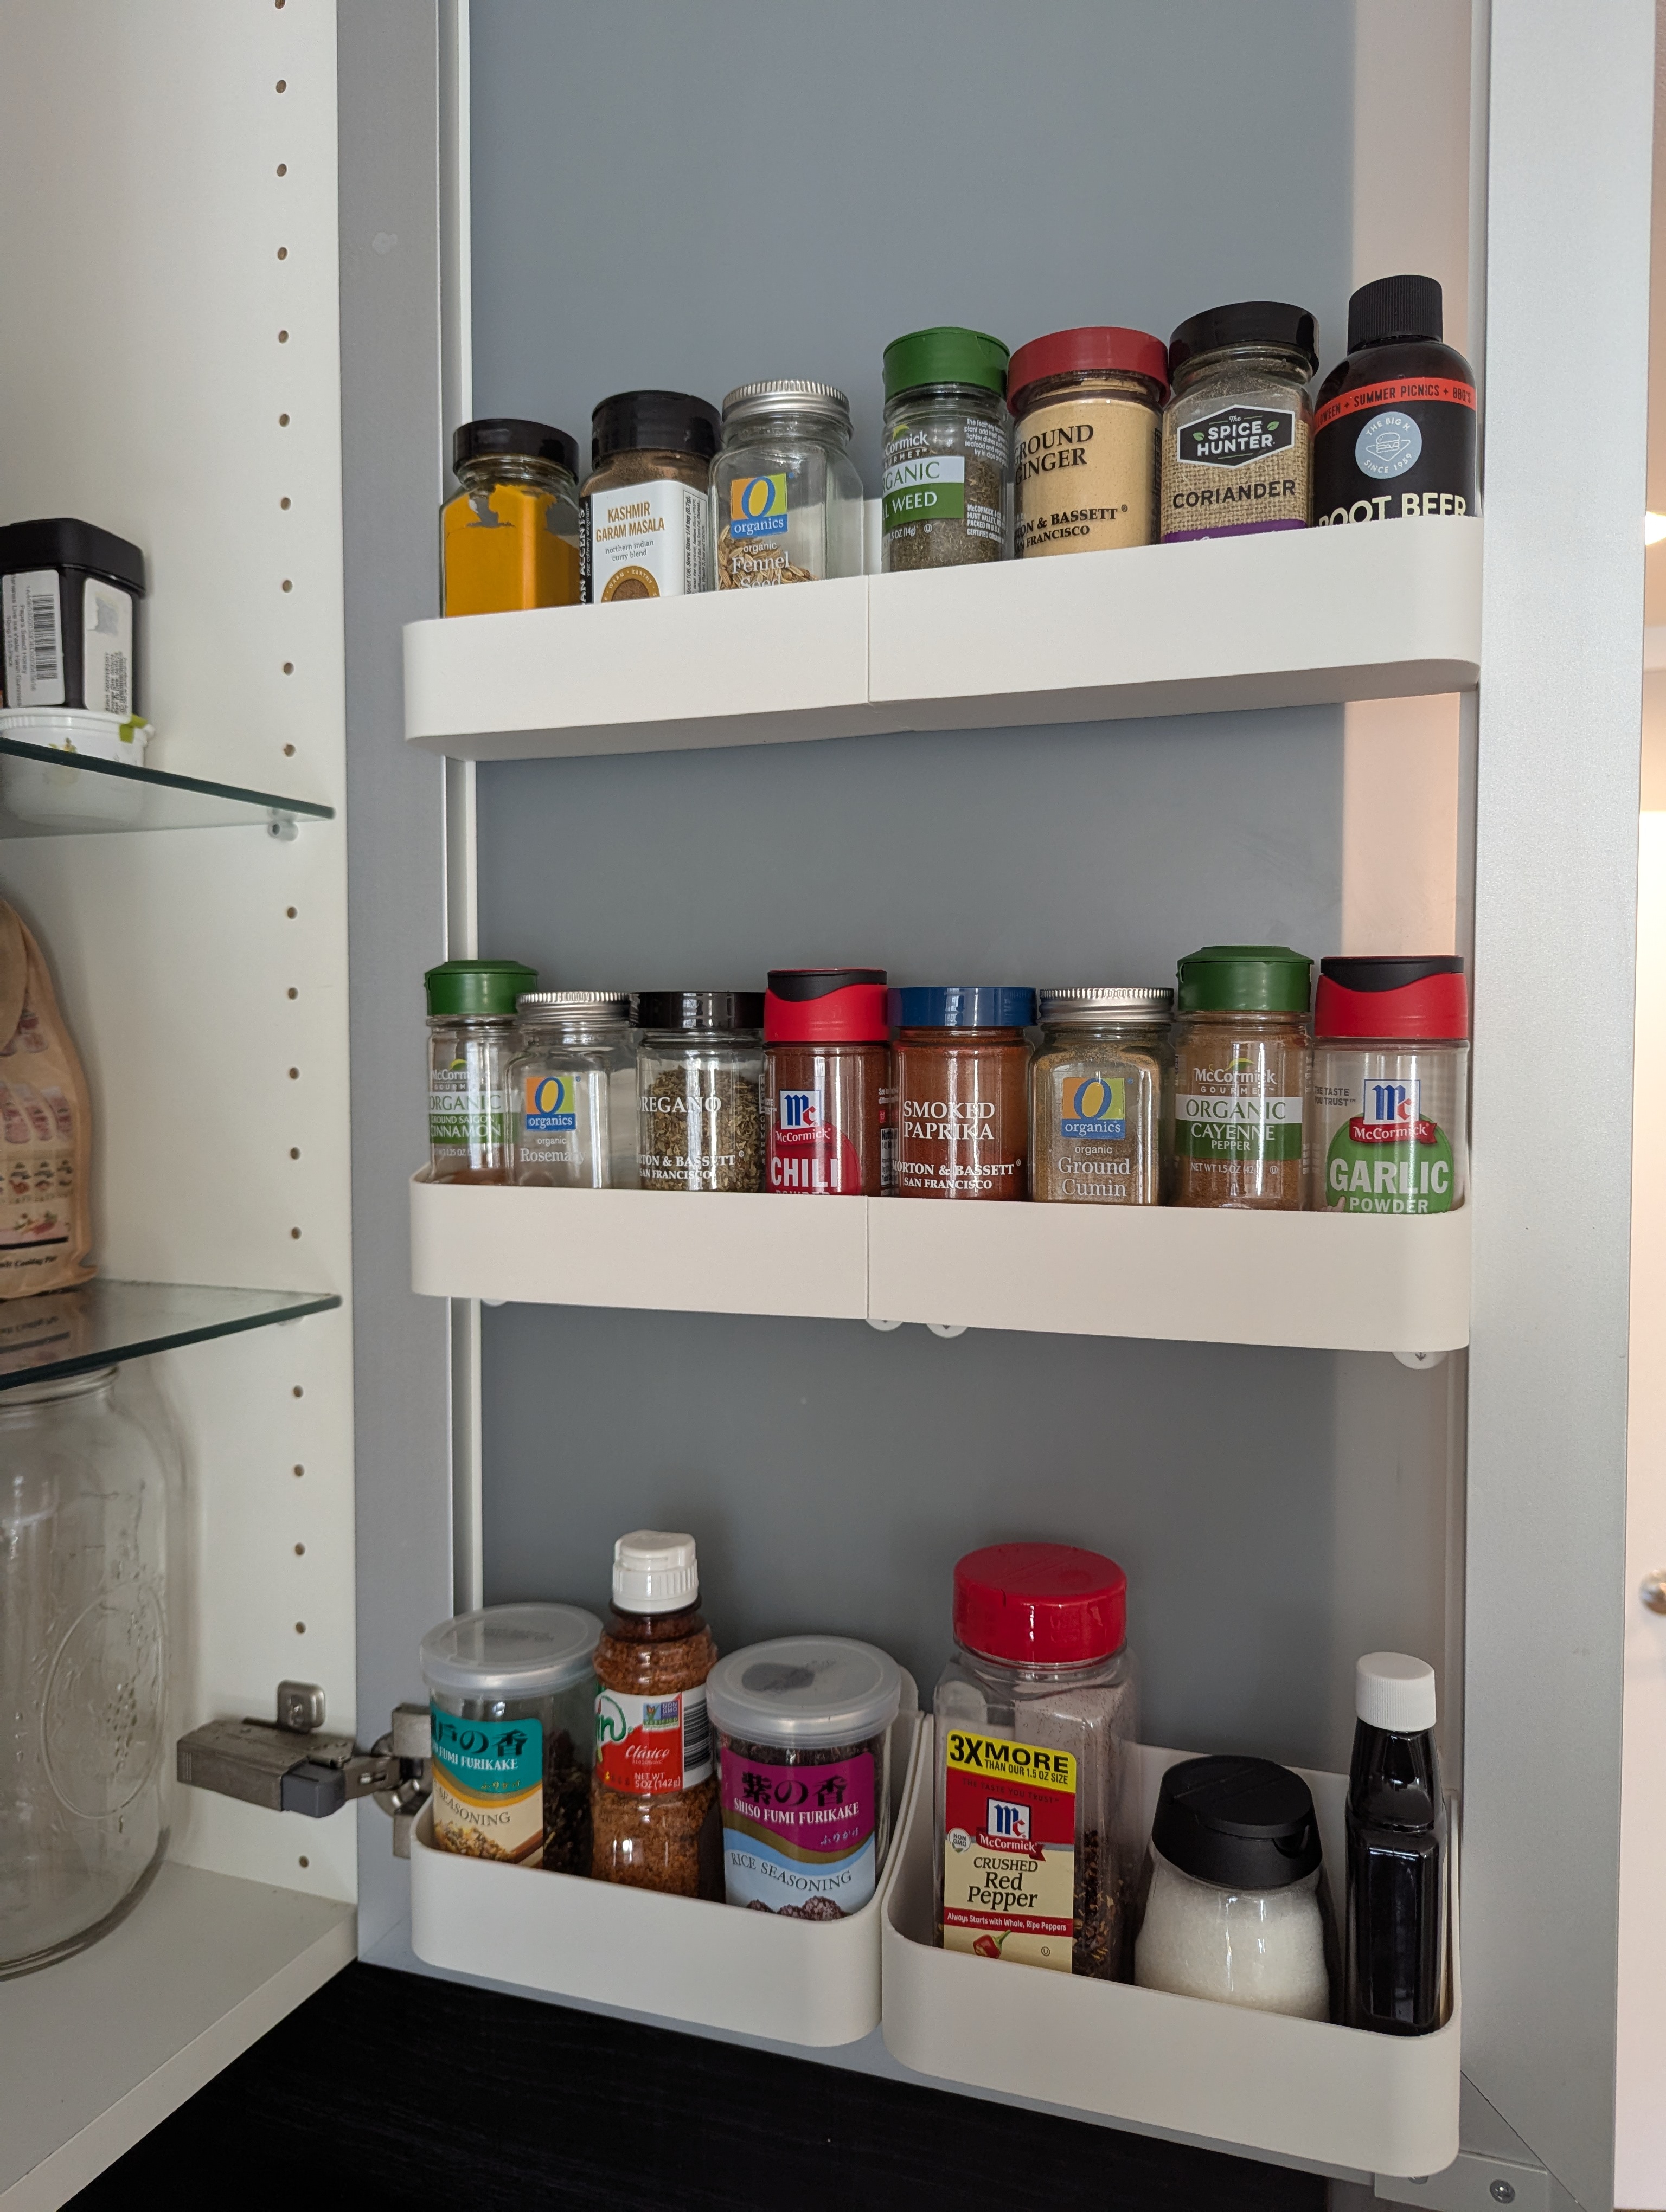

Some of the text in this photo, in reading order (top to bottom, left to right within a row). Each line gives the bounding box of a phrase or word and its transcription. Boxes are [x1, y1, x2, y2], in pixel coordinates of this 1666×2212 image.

[1354, 387, 1395, 407] SUMMER
[1401, 384, 1440, 397] PICNICS
[1208, 421, 1263, 440] SPICE
[1366, 417, 1411, 436] THE BIG H
[1197, 434, 1273, 456] HUNTER
[883, 450, 921, 467] OURMET
[1015, 447, 1087, 486] GINGER
[1364, 453, 1412, 473] SINCE 1959
[892, 492, 937, 513] WEED
[1172, 480, 1296, 509] CORIANDER
[608, 501, 650, 523] KASHMIR
[1402, 492, 1466, 518] BEER
[967, 512, 981, 520] HUNT
[967, 519, 985, 529] PACKED
[1037, 517, 1047, 529] &
[1051, 508, 1118, 526] BASSETT
[596, 517, 665, 543] GARAM MASALA
[734, 518, 784, 535] organics
[1026, 525, 1090, 548] FRANCISCO
[605, 540, 654, 554] northern indian
[612, 549, 647, 562] curry blend
[744, 542, 777, 554] organic
[733, 551, 790, 574] Fennel
[609, 569, 652, 589] WARM EARTHY
[740, 574, 781, 588] Seed
[1324, 1087, 1349, 1096] TASTE
[904, 1101, 995, 1118] SMOKED
[1186, 1099, 1286, 1120] ORGANIC
[1324, 1097, 1349, 1107] TRUST
[529, 1115, 573, 1129] organics
[904, 1122, 995, 1140] PAPRIKA
[1065, 1121, 1120, 1136] organics
[1191, 1123, 1275, 1140] CAYENNE
[1353, 1123, 1428, 1140] McCormick
[537, 1136, 567, 1147] organic
[775, 1128, 830, 1142] McCormick
[1075, 1144, 1113, 1156] organic
[1212, 1140, 1251, 1150] PEPPER
[662, 1156, 672, 1167] &
[893, 1160, 1014, 1175] MORTON & BASSETT
[1058, 1156, 1131, 1175] Ground
[1191, 1162, 1203, 1172] NET
[1204, 1163, 1216, 1172] WT
[1229, 1165, 1241, 1174] OZ
[652, 1170, 712, 1179] FRANCISCO
[771, 1156, 840, 1187] CHILI
[1330, 1158, 1449, 1194] GARLIC
[904, 1177, 992, 1189] SAN FRANCISCO
[1062, 1178, 1127, 1197] Cumin
[1350, 1197, 1428, 1214] POWDER
[431, 1713, 528, 1757] 戸の香
[439, 1746, 458, 1765] FUMI
[462, 1756, 518, 1771] FURIKAKE
[985, 1759, 1068, 1785] THAN OUR 1.5 OZ SIZE
[655, 1776, 681, 1790] (142g)
[741, 1771, 847, 1806] 紫の香
[963, 1778, 977, 1787] THE
[981, 1782, 1004, 1793] TASTE
[1009, 1788, 1024, 1797] YOU
[439, 1786, 511, 1827] SEASONING
[734, 1797, 859, 1825] SHISO FUMI FURIKAKE
[953, 1832, 966, 1841] NON
[979, 1834, 1036, 1853] McCormick
[731, 1852, 851, 1892] RICE SEASONING
[973, 1856, 1038, 1872] CRUSHED
[984, 1871, 1022, 1891] Red
[967, 1885, 1038, 1912] Pepper
[947, 1912, 1066, 1931] Always Starts with Whole, Ripe Peppers
